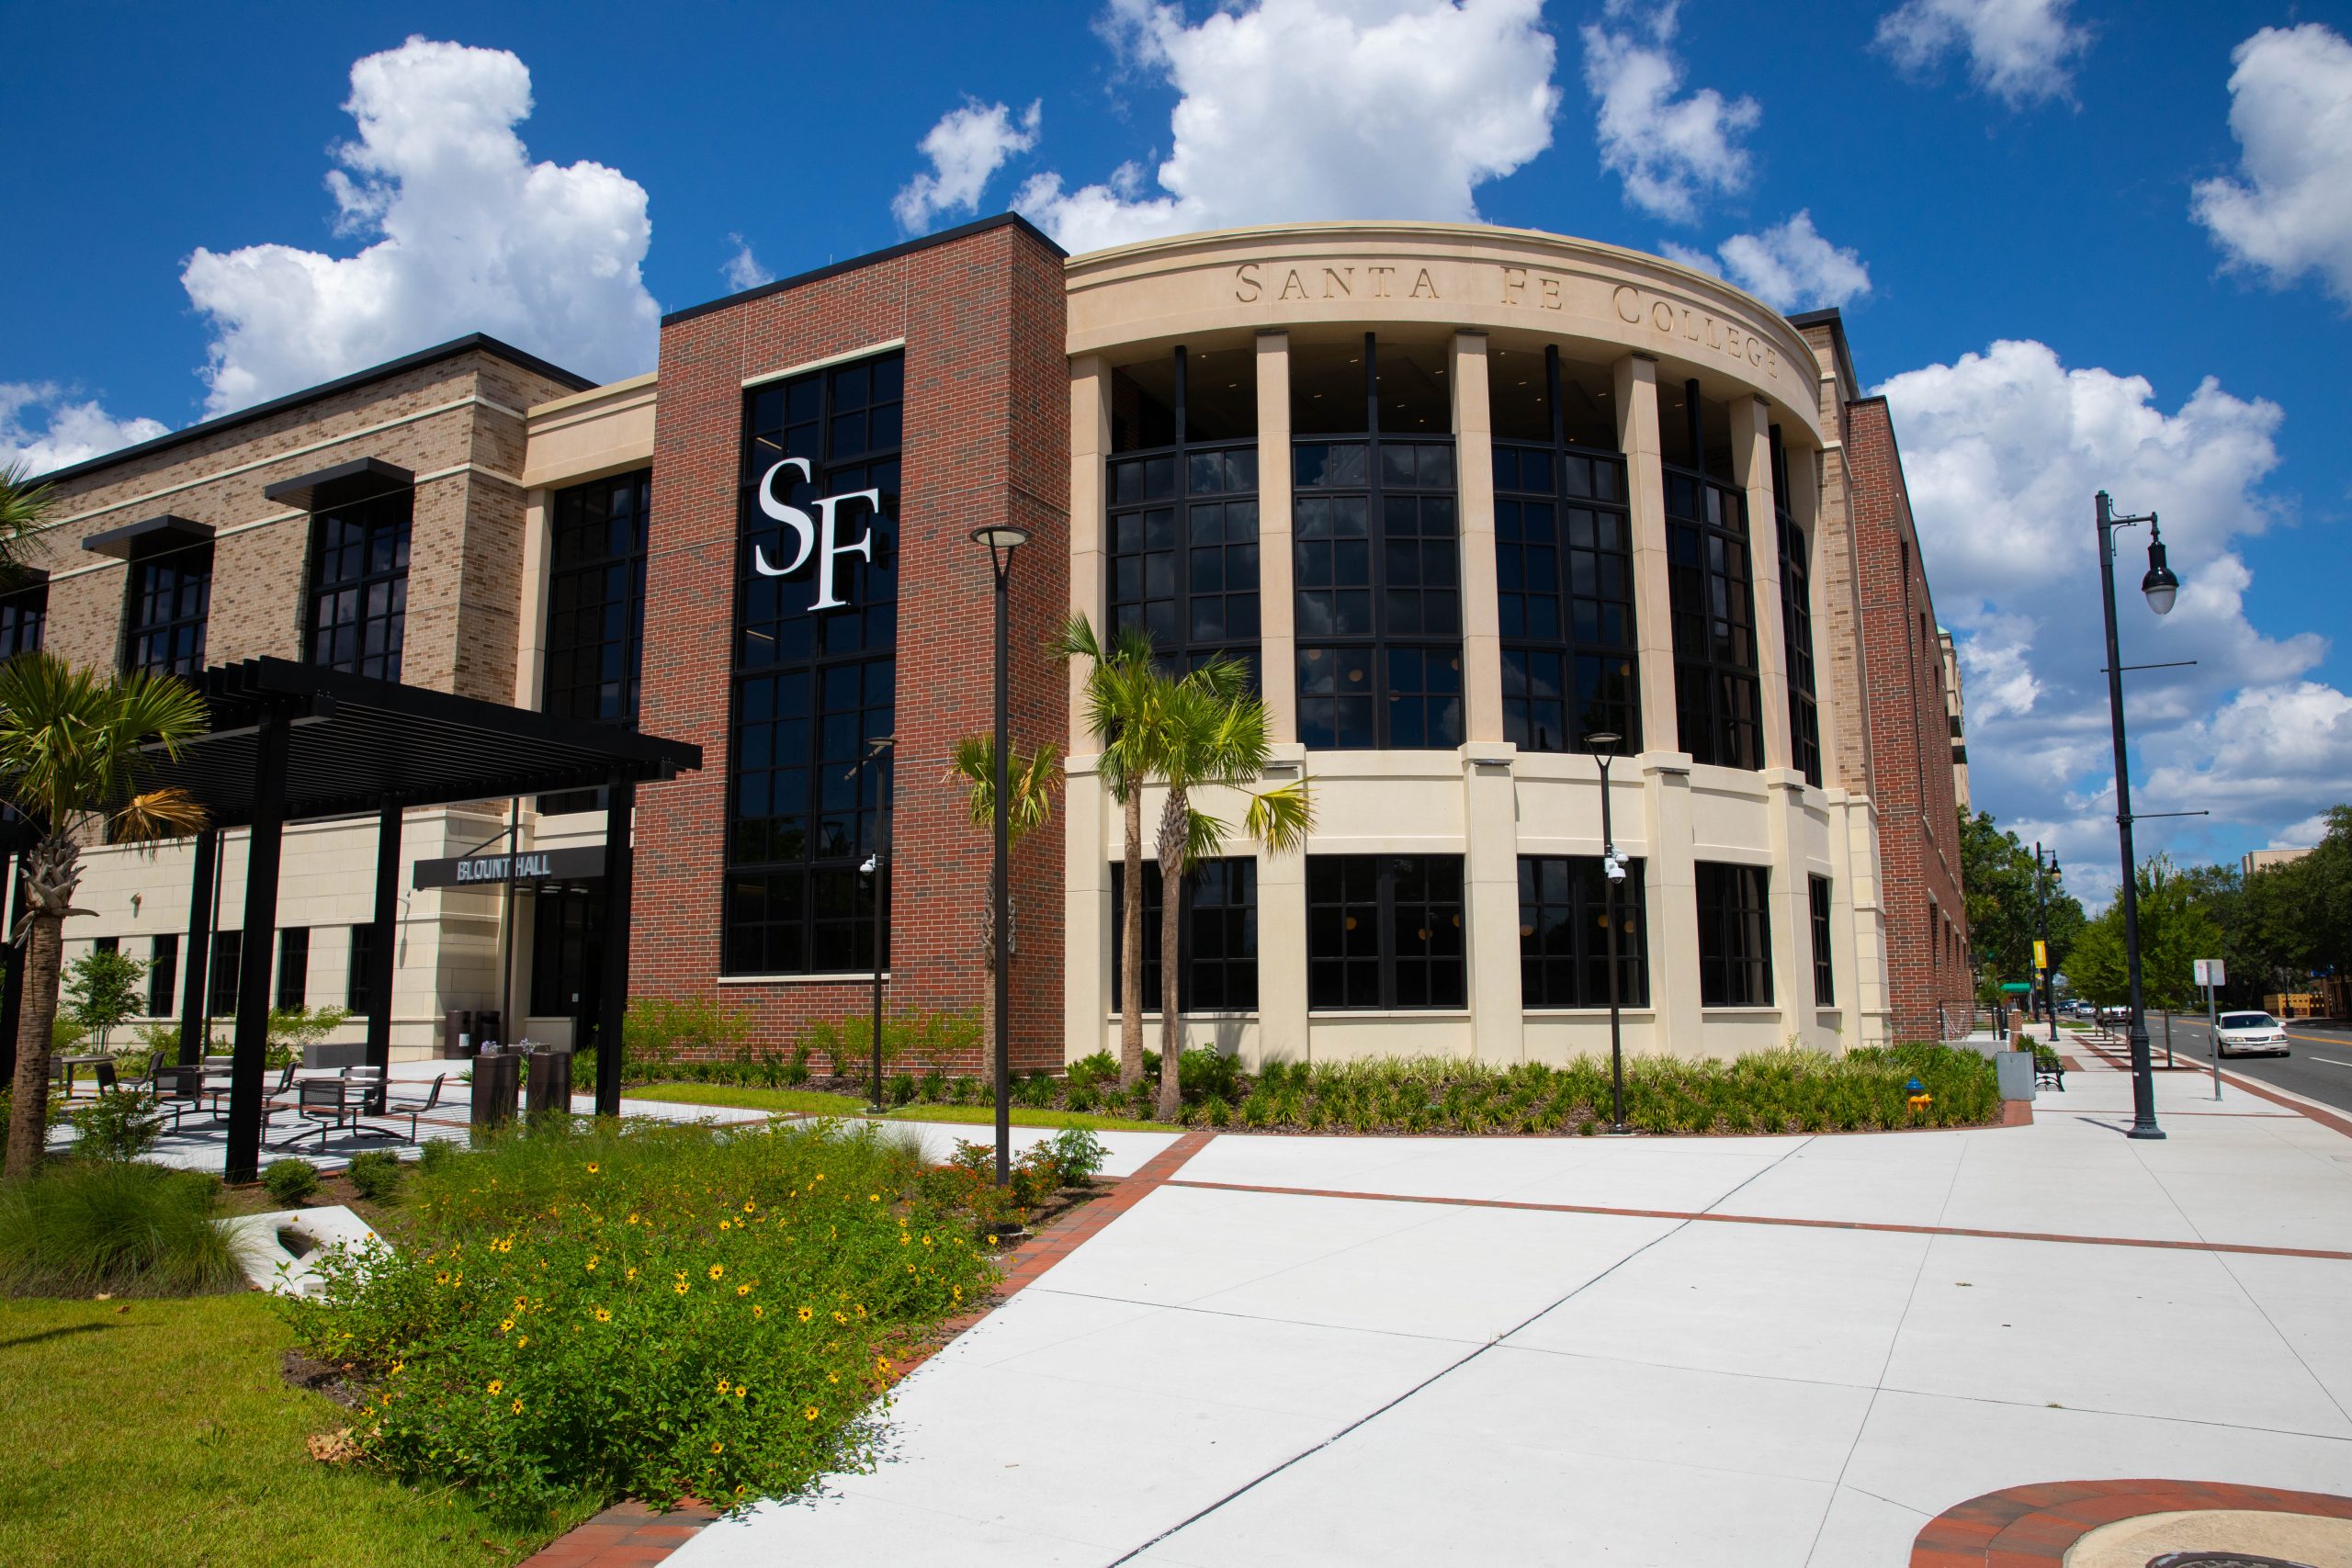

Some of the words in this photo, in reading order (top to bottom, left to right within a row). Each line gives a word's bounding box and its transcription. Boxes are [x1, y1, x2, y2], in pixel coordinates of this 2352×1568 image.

[1236, 264, 1441, 303] SANTA
[1499, 265, 1563, 310] FE
[1613, 285, 1778, 379] COLLEGE
[755, 457, 879, 612] SF
[458, 857, 511, 881] BLOUNT
[514, 854, 551, 877] HALL
